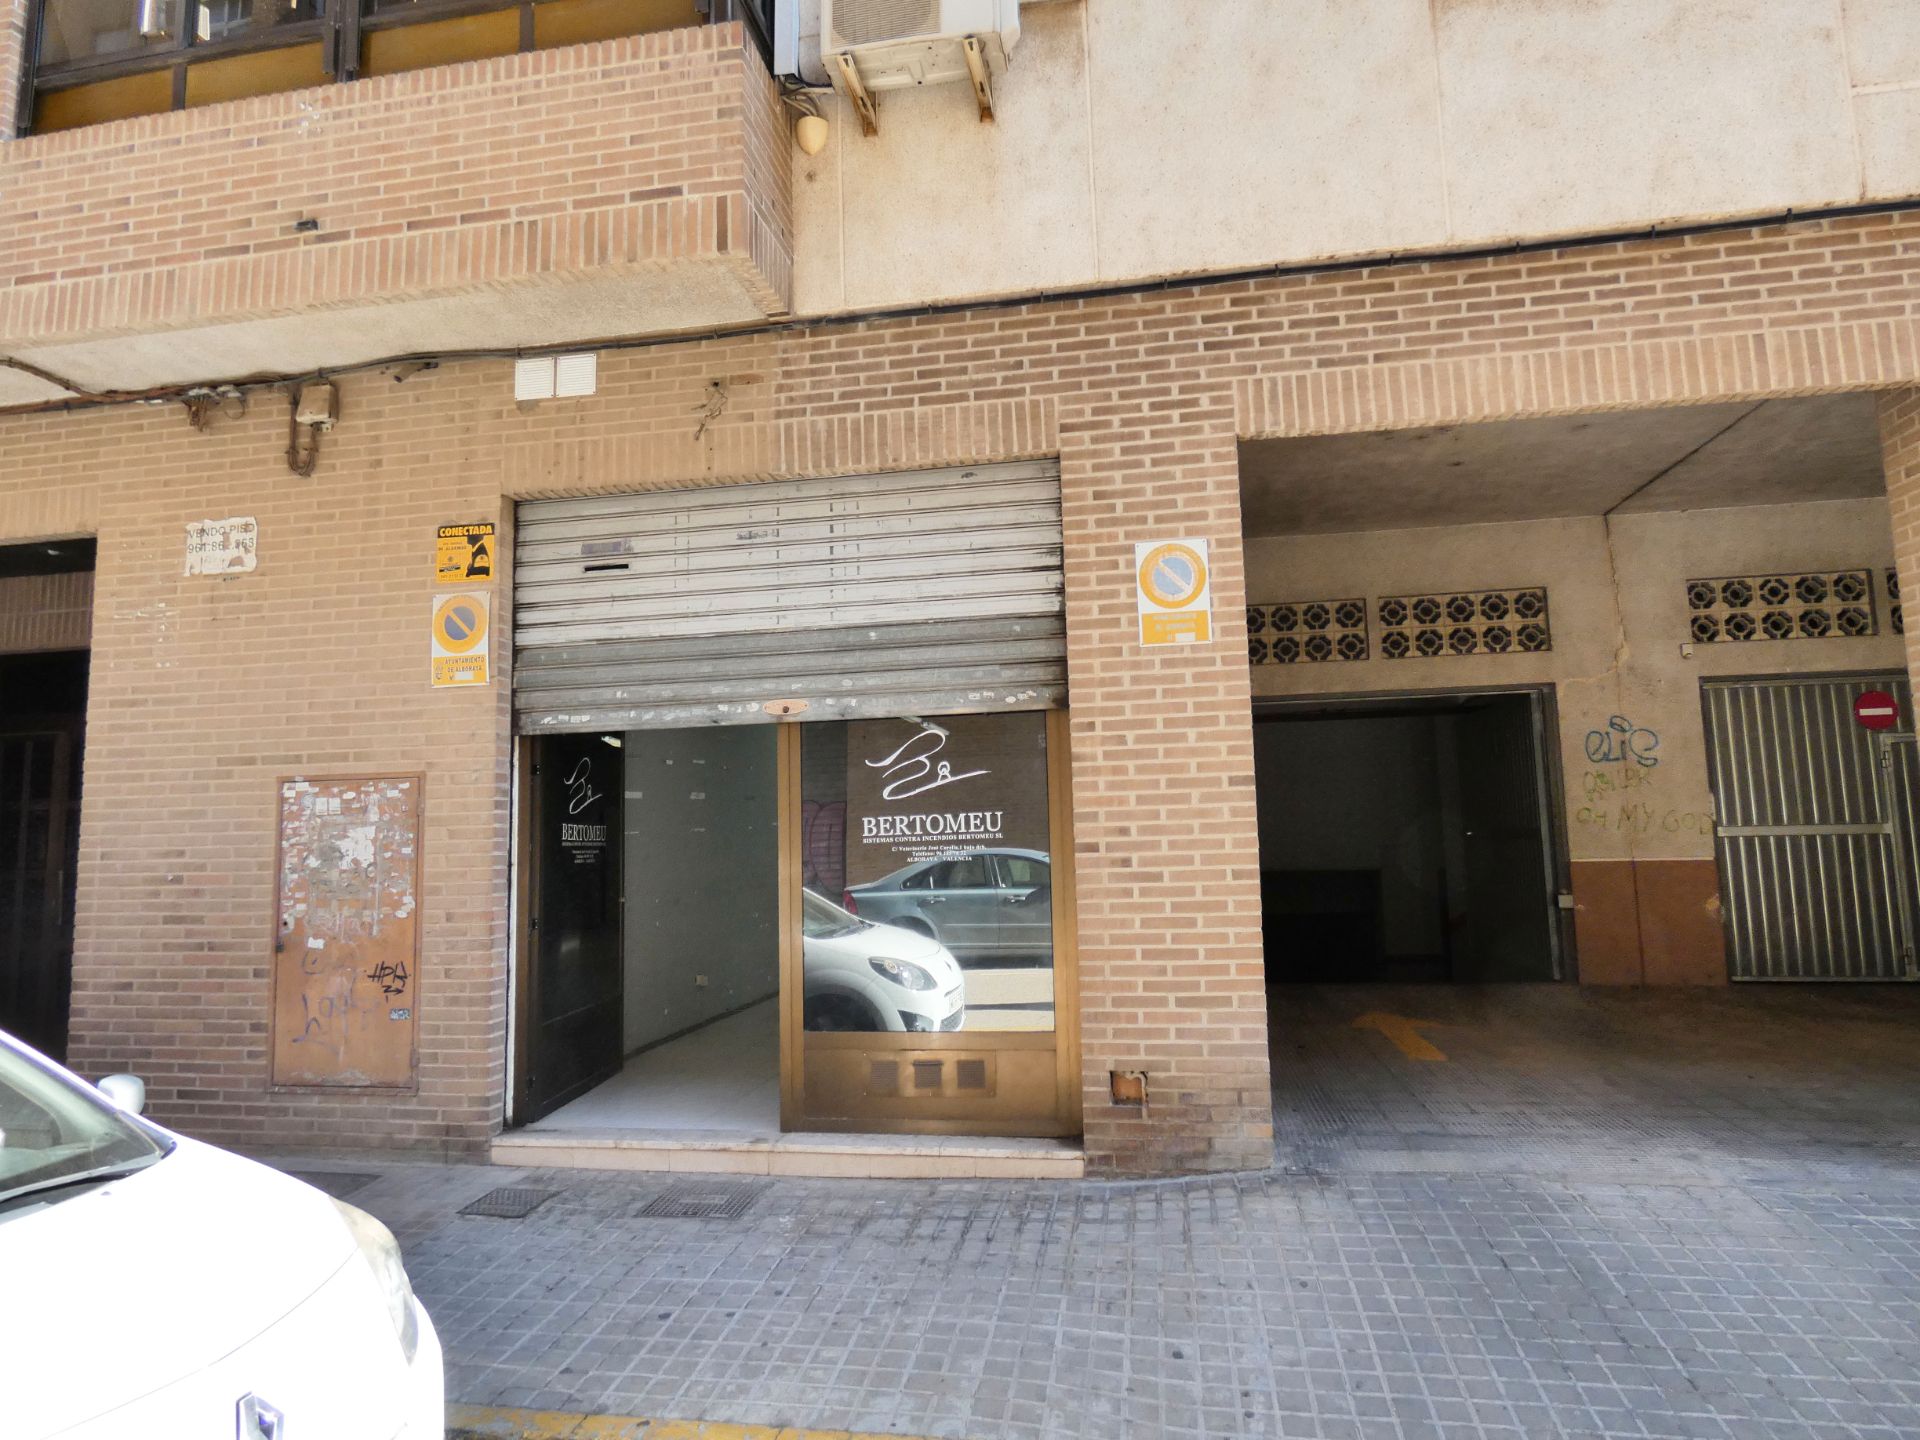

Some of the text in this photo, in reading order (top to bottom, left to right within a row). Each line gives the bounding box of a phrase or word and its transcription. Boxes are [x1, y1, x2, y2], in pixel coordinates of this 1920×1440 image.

[188, 523, 255, 538] VENDO PISO
[440, 525, 493, 537] CONECTADA
[861, 811, 1004, 837] BERTOMEU
[562, 823, 607, 841] BERTOMEU
[862, 836, 894, 844] SISTEMAS
[922, 834, 958, 842] INCENDIOS
